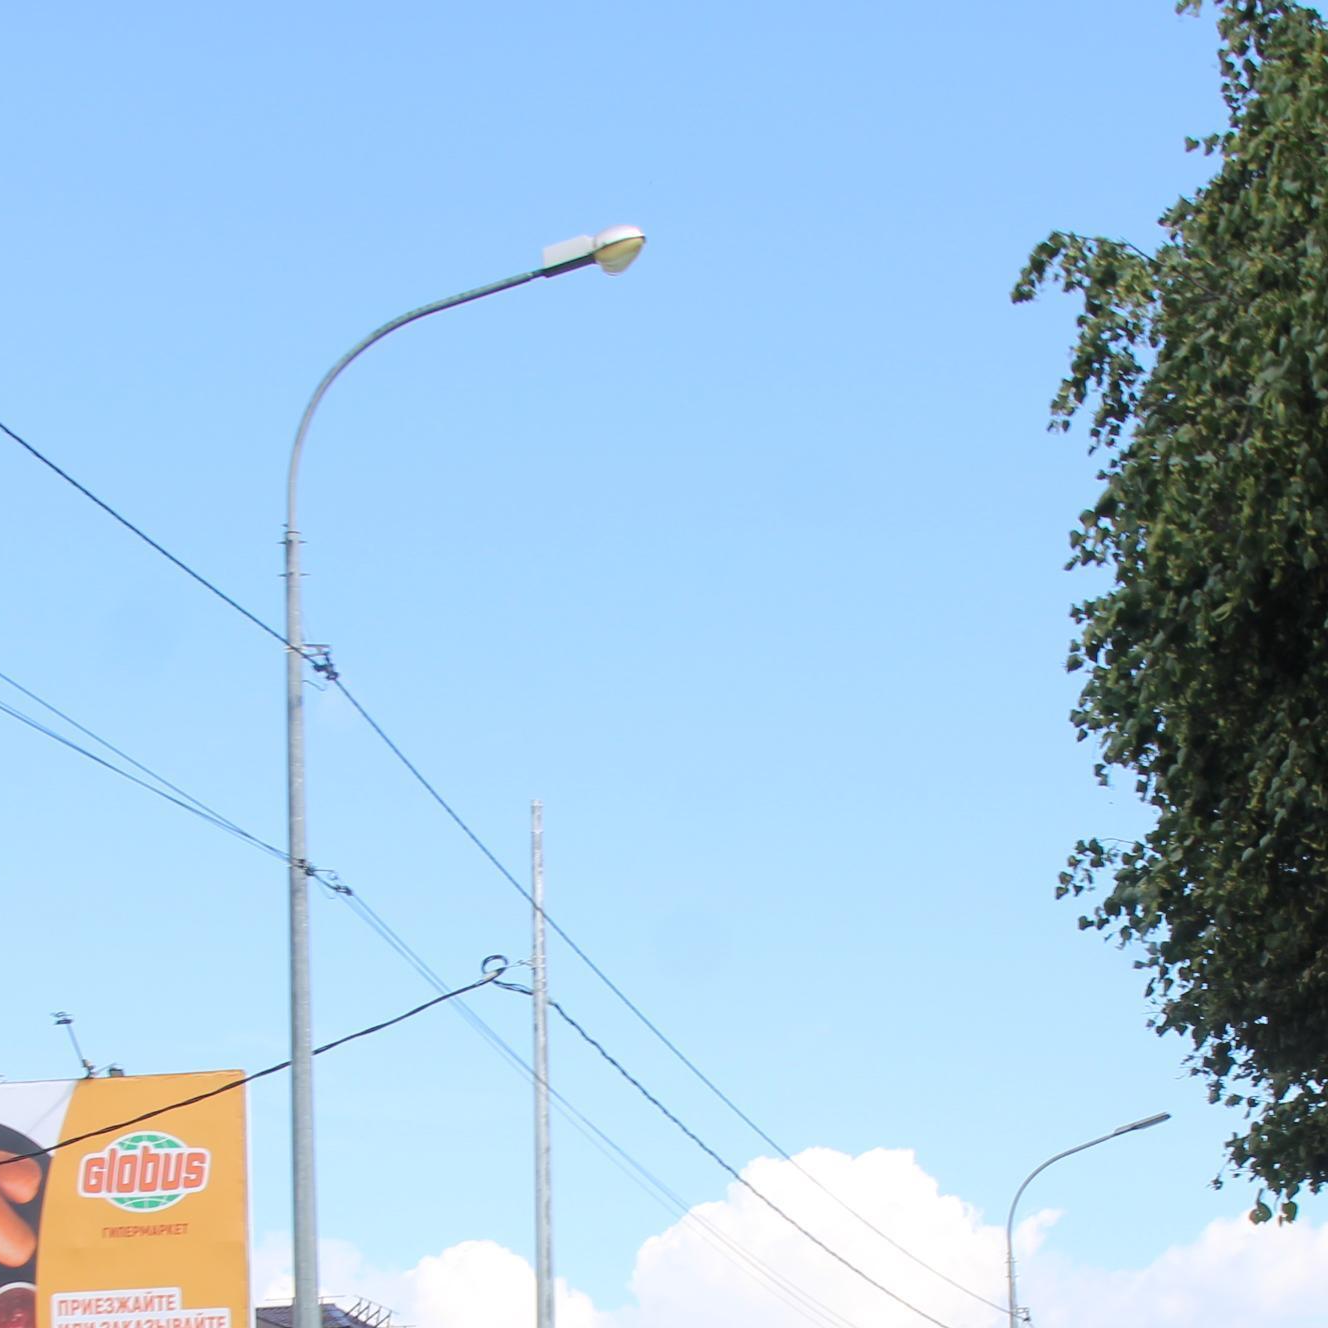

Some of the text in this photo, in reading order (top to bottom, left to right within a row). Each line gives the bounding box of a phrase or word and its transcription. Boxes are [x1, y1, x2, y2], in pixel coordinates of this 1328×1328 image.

[83, 1145, 208, 1194] Globus
[102, 1223, 189, 1238] ГИПЕРМАРКЕТ
[57, 1292, 176, 1316] ПРИЕЗЖАЙТЕ
